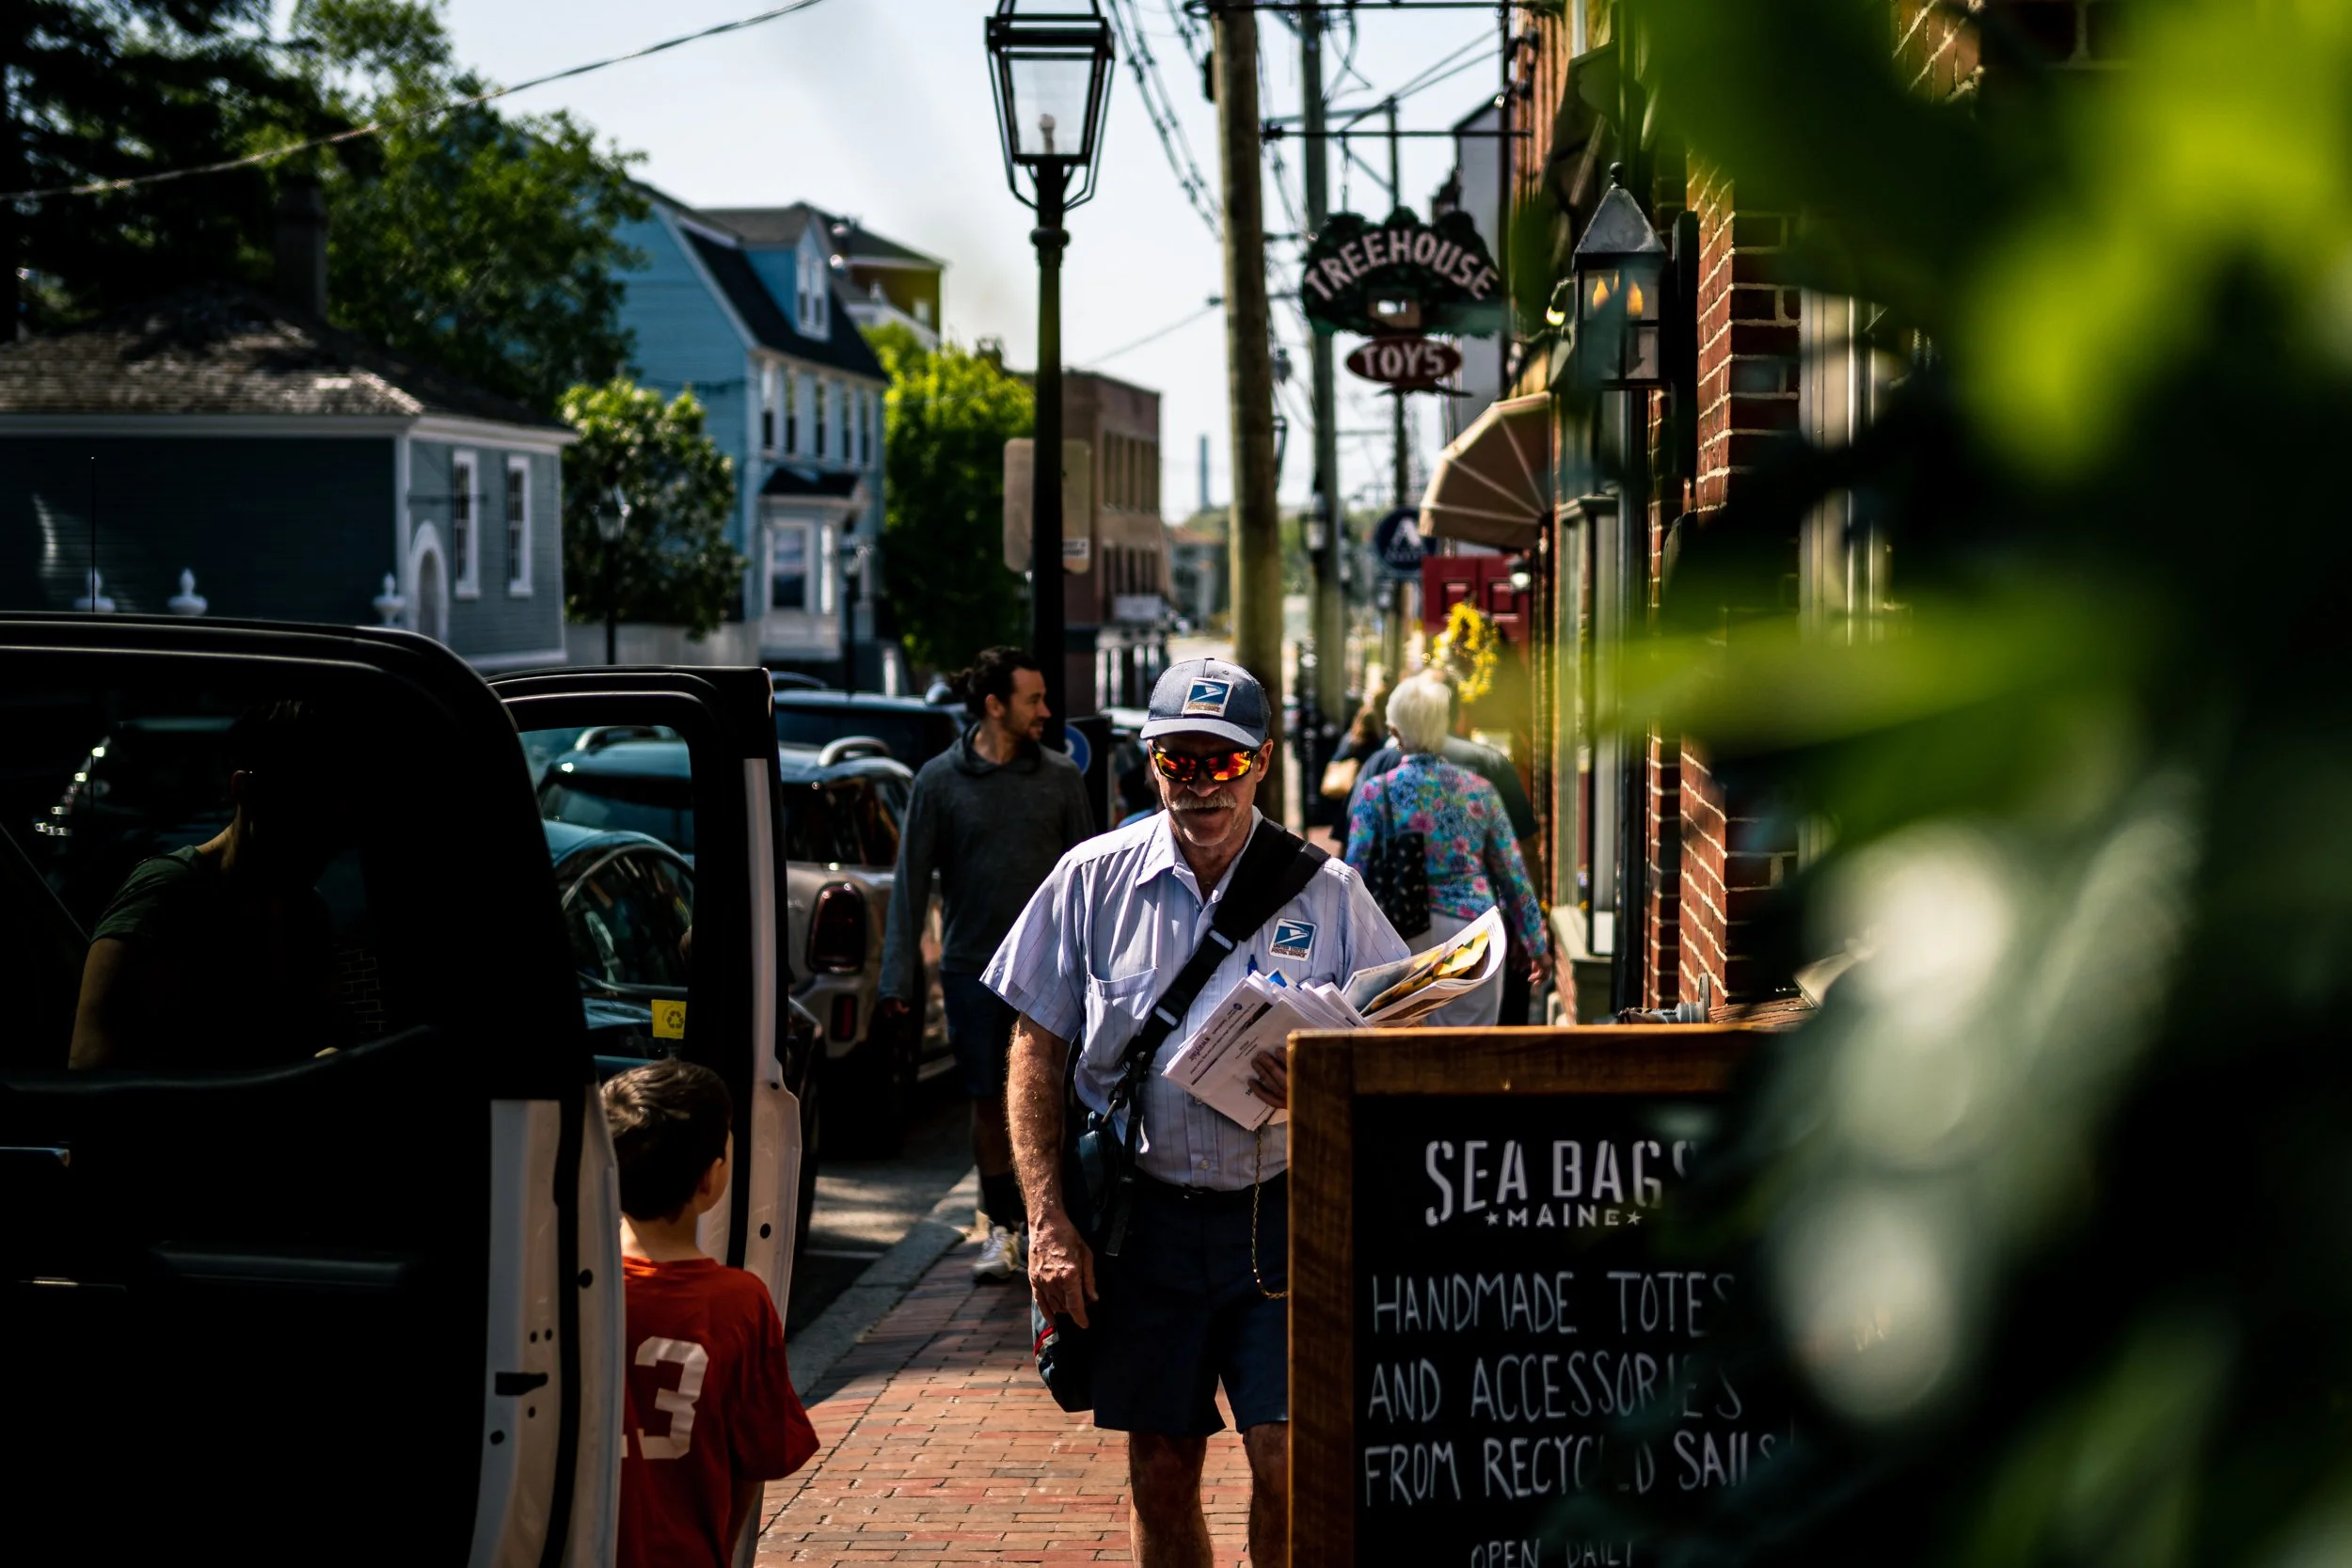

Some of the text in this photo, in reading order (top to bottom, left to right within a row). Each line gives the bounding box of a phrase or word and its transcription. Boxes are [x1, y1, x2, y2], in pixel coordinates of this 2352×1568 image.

[1304, 229, 1501, 301] TREEHOUSE
[1361, 340, 1446, 378] TOYS
[1424, 1139, 1529, 1228] SEA
[1507, 1203, 1620, 1228] MAINE
[1372, 1270, 1579, 1337] HANDMADE
[622, 1335, 710, 1461] 3
[1366, 1355, 1442, 1425] AND
[1363, 1441, 1464, 1509] FROM
[1484, 1432, 1657, 1502] RECYCD
[1470, 1537, 1542, 1568] OPEN
